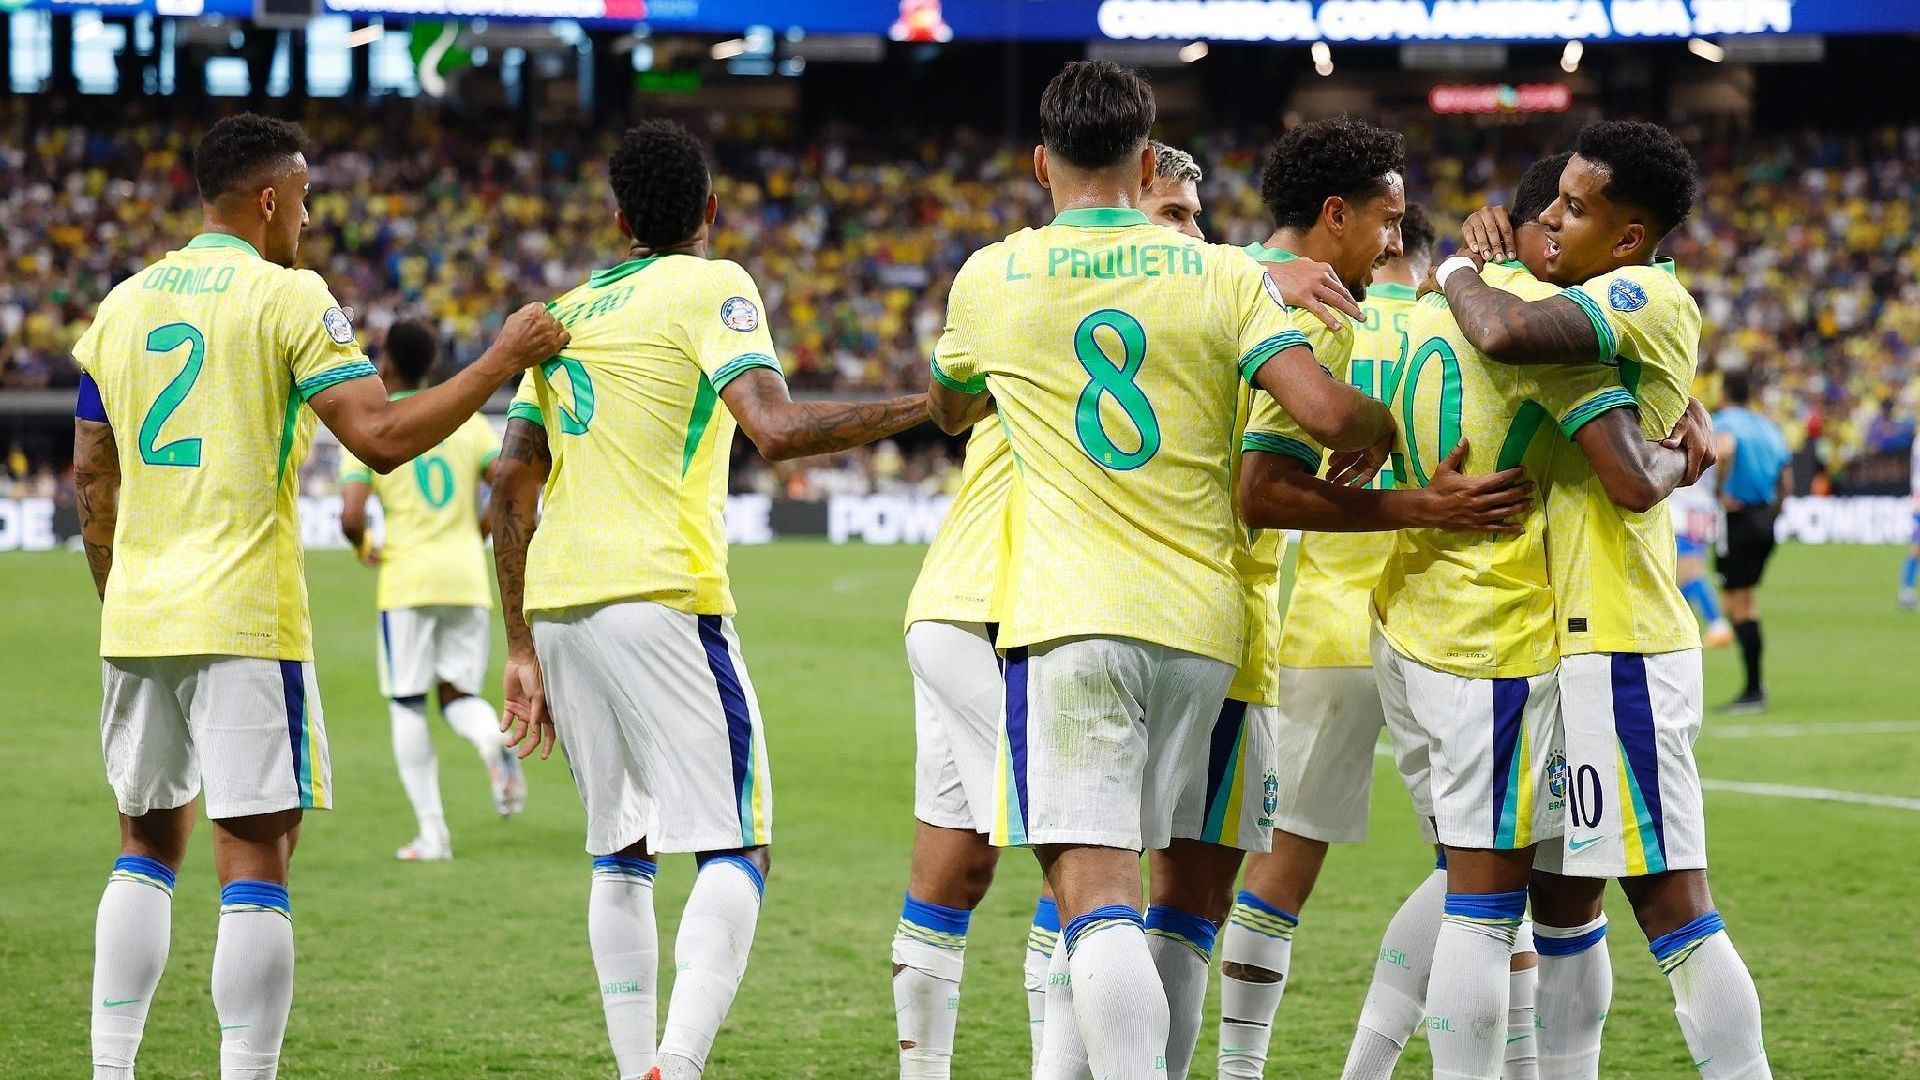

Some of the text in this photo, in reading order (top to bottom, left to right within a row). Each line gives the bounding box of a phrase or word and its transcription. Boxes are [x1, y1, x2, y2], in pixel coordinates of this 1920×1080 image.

[142, 265, 236, 295] DANILO
[1006, 252, 1032, 282] L.
[138, 322, 205, 467] 2
[1074, 308, 1161, 471] 8
[1567, 764, 1603, 829] 10
